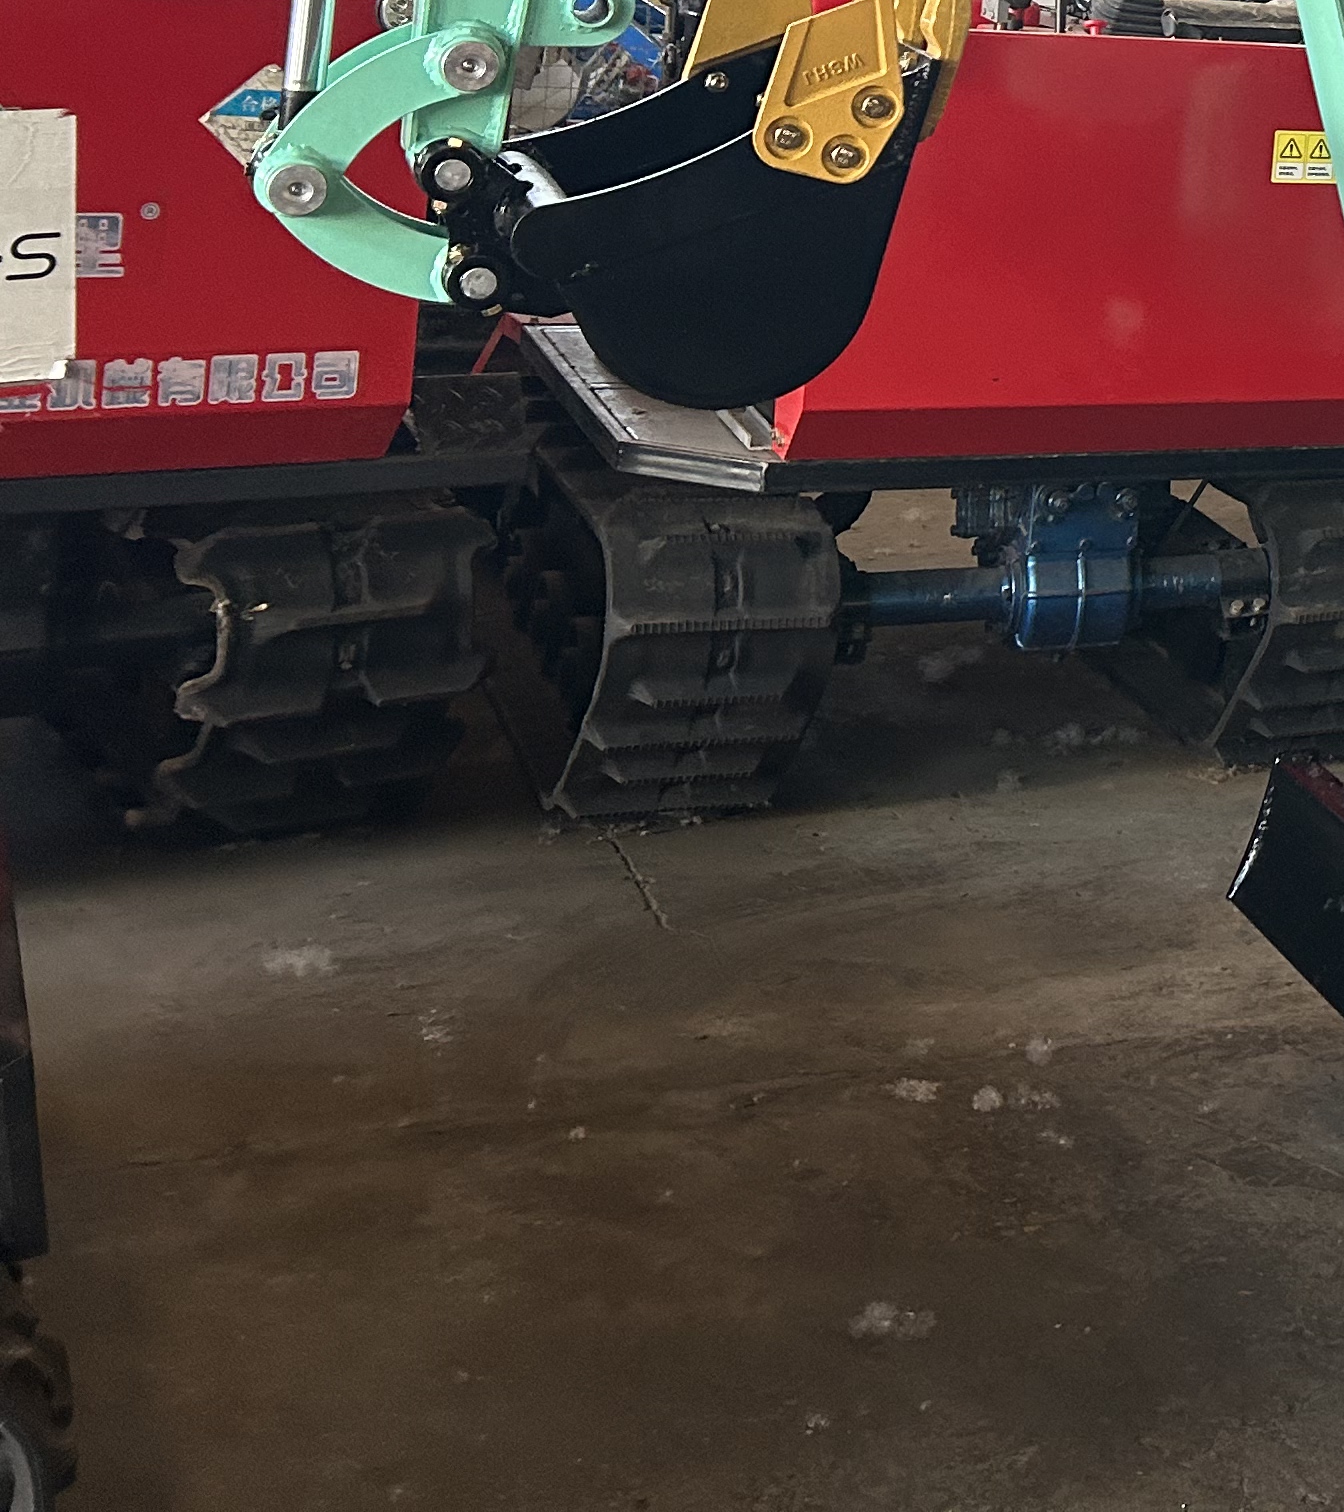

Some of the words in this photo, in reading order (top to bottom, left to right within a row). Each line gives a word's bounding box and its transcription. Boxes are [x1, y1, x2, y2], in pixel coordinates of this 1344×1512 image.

[0, 350, 360, 414] 机械有限公司
